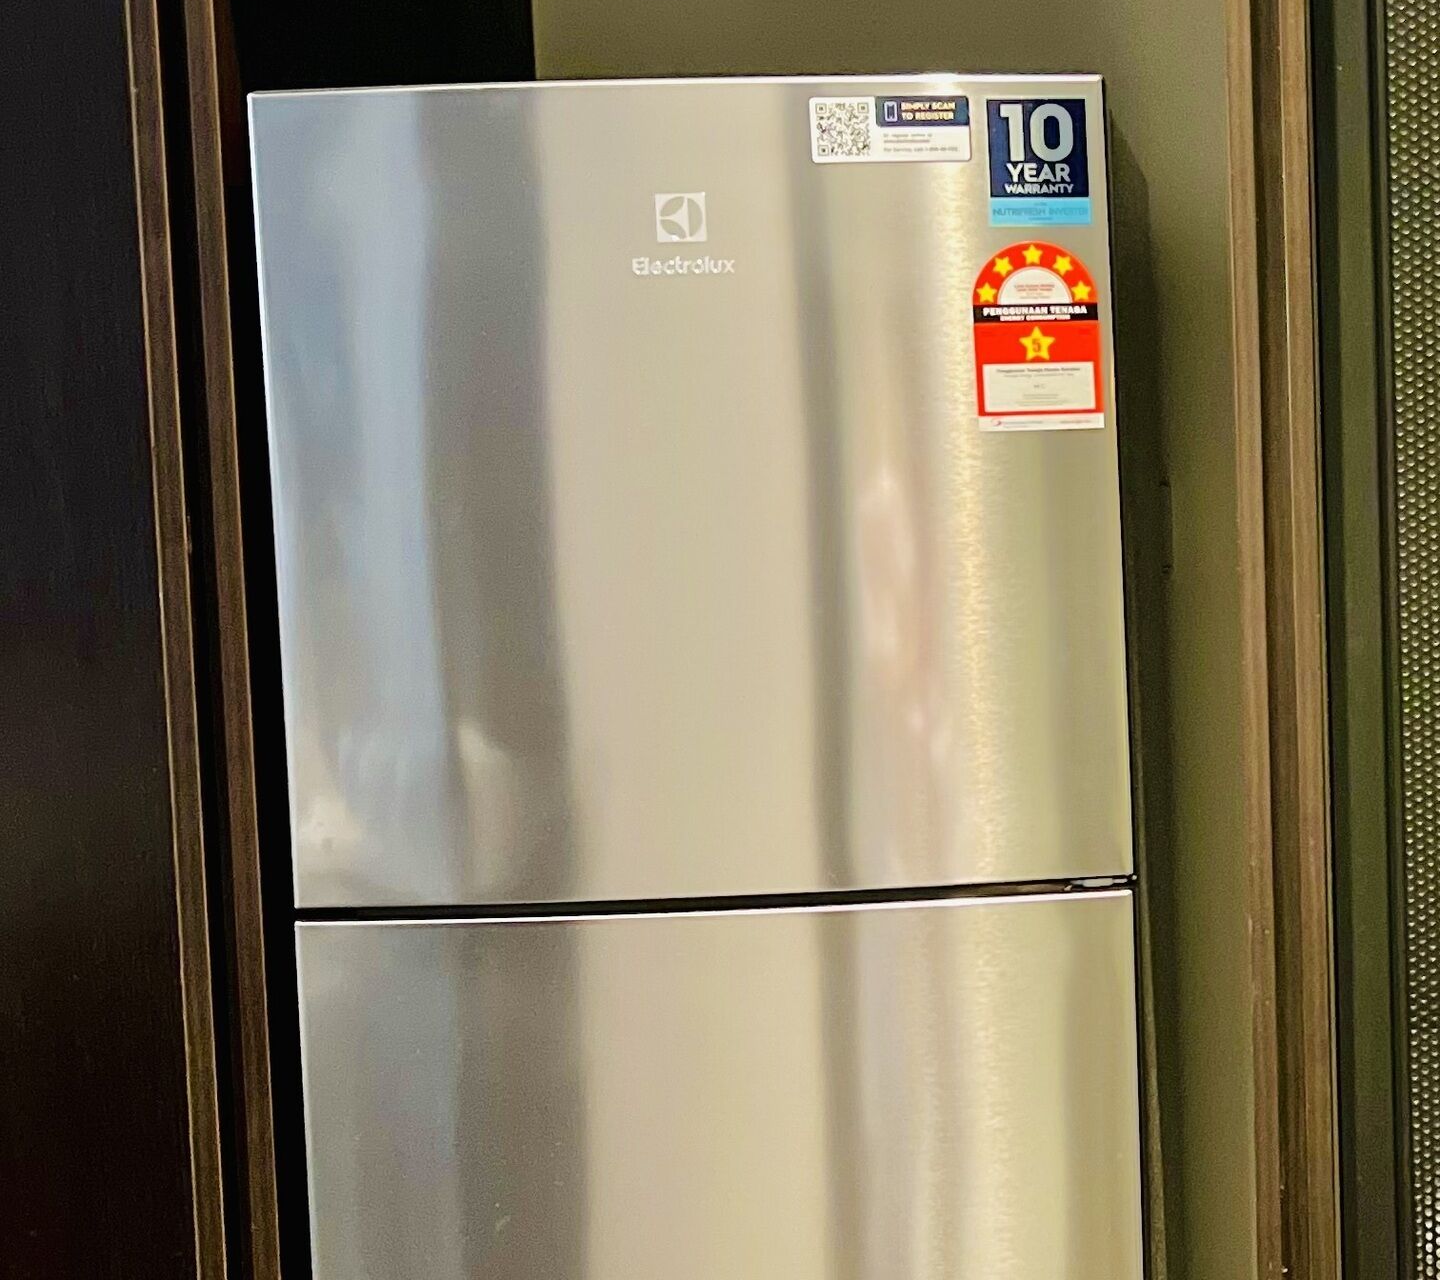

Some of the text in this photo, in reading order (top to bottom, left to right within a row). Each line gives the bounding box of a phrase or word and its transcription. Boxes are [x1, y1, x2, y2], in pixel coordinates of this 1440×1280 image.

[901, 101, 956, 110] SIMPLY SCAN
[901, 111, 954, 121] TO REGISTER
[999, 103, 1074, 162] 10
[1005, 162, 1071, 183] YEAR
[1004, 183, 1074, 195] WARRANTY
[631, 255, 736, 276] Electrolux
[982, 305, 1088, 316] PENGGUNAAN TENAGA
[1032, 338, 1041, 352] 5
